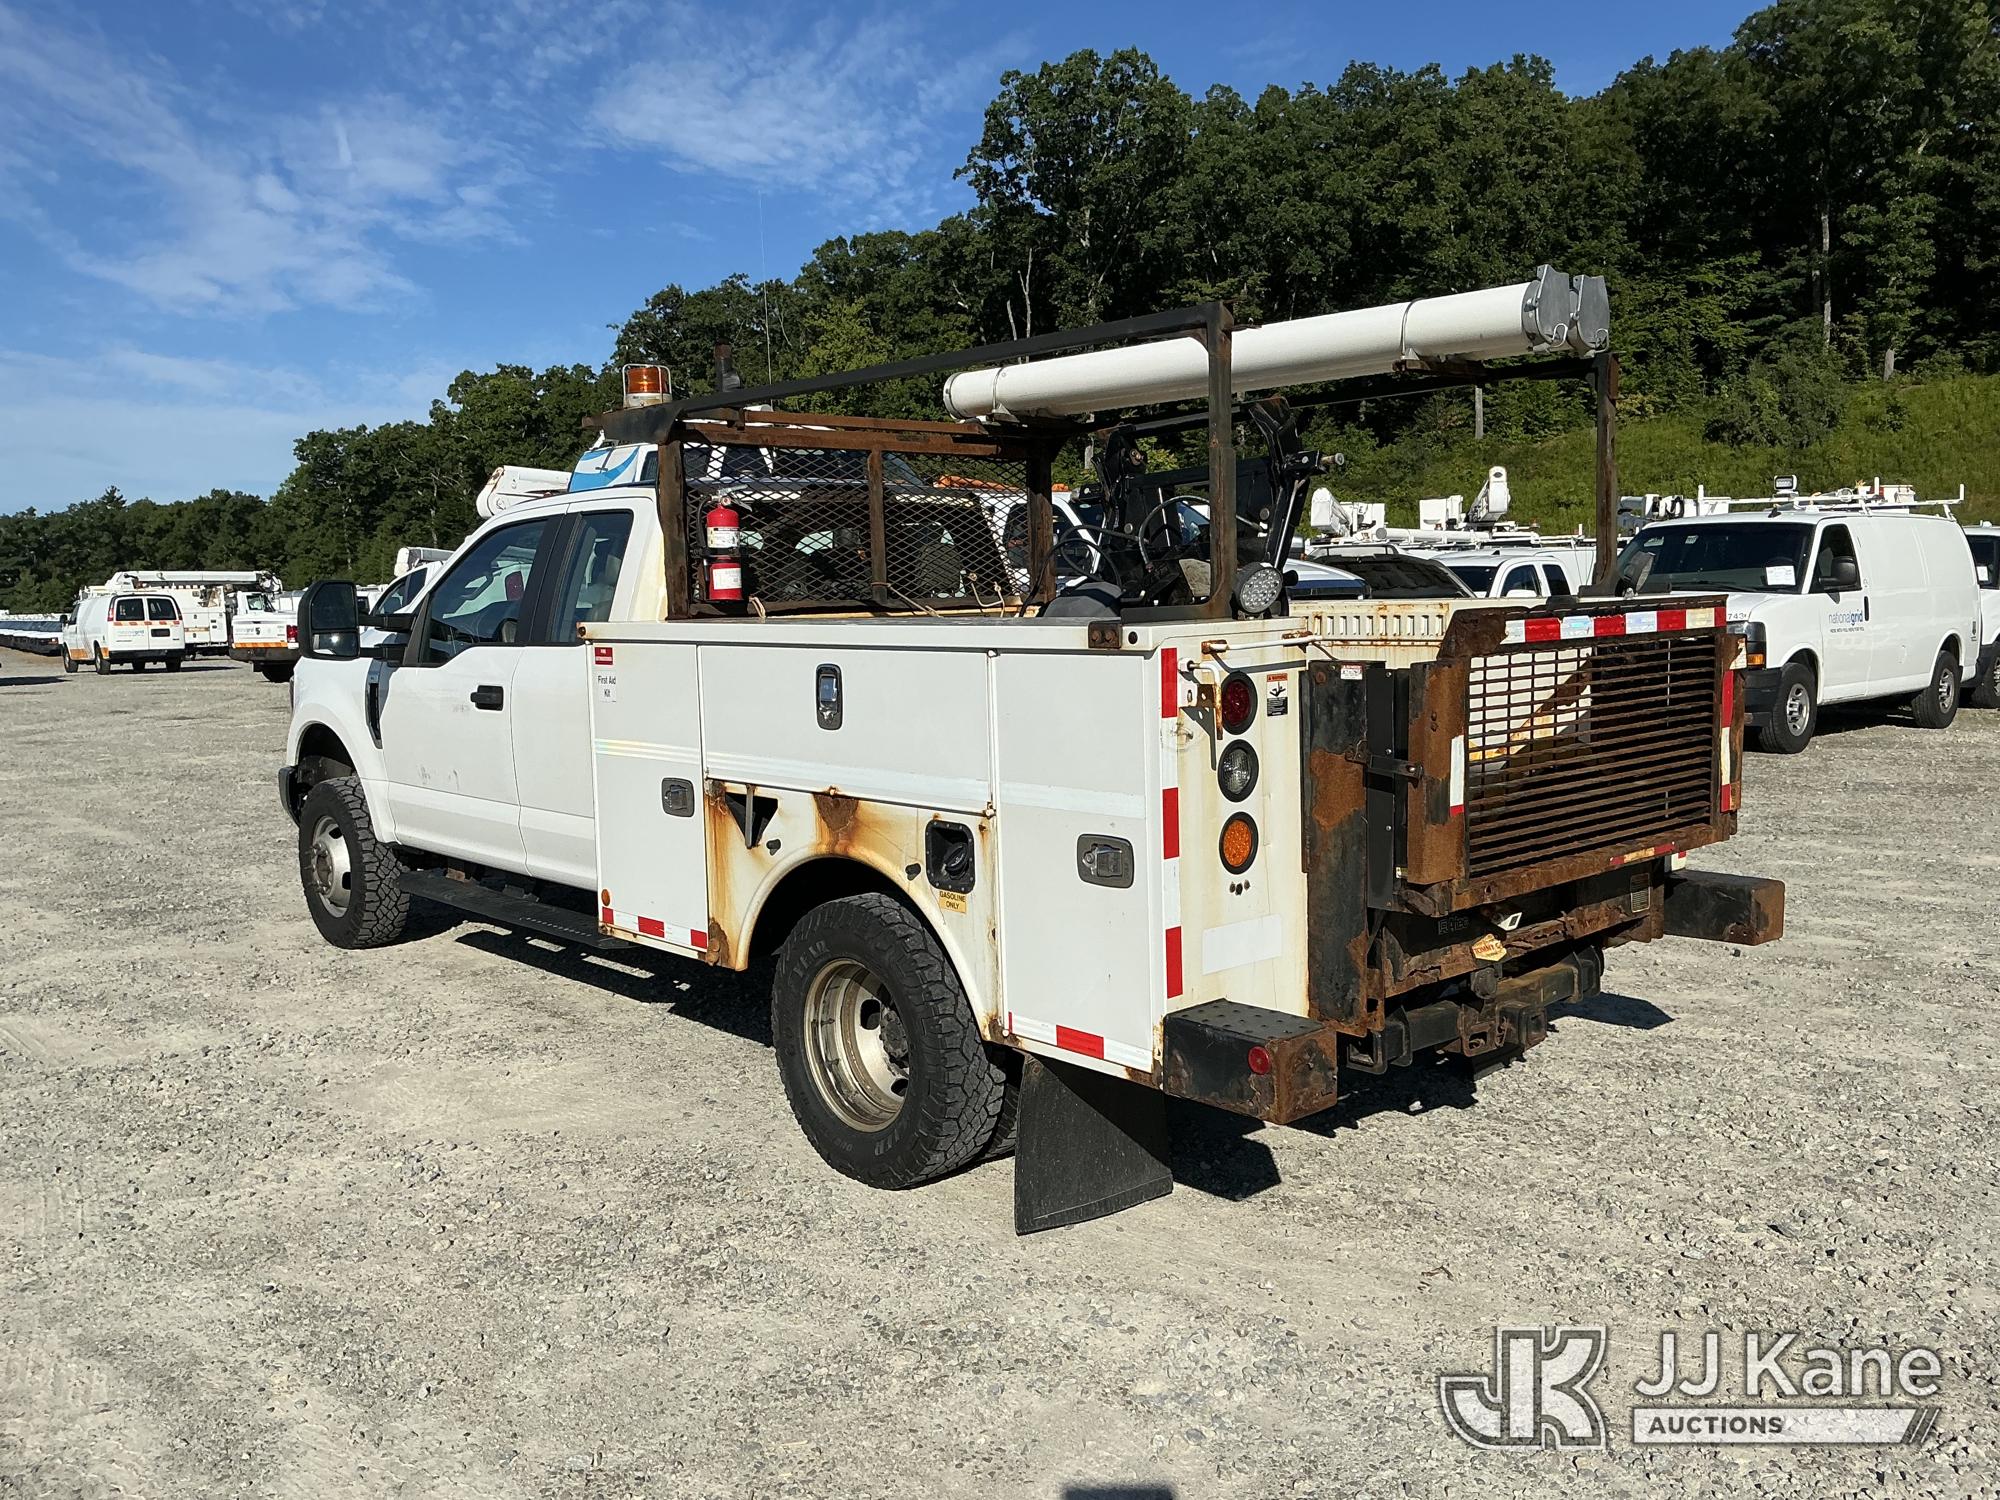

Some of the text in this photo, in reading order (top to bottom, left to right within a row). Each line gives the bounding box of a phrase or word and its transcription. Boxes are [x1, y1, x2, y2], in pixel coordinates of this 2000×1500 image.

[598, 675, 608, 685] First
[940, 890, 966, 902] GASOLINE
[945, 900, 960, 909] ONLY
